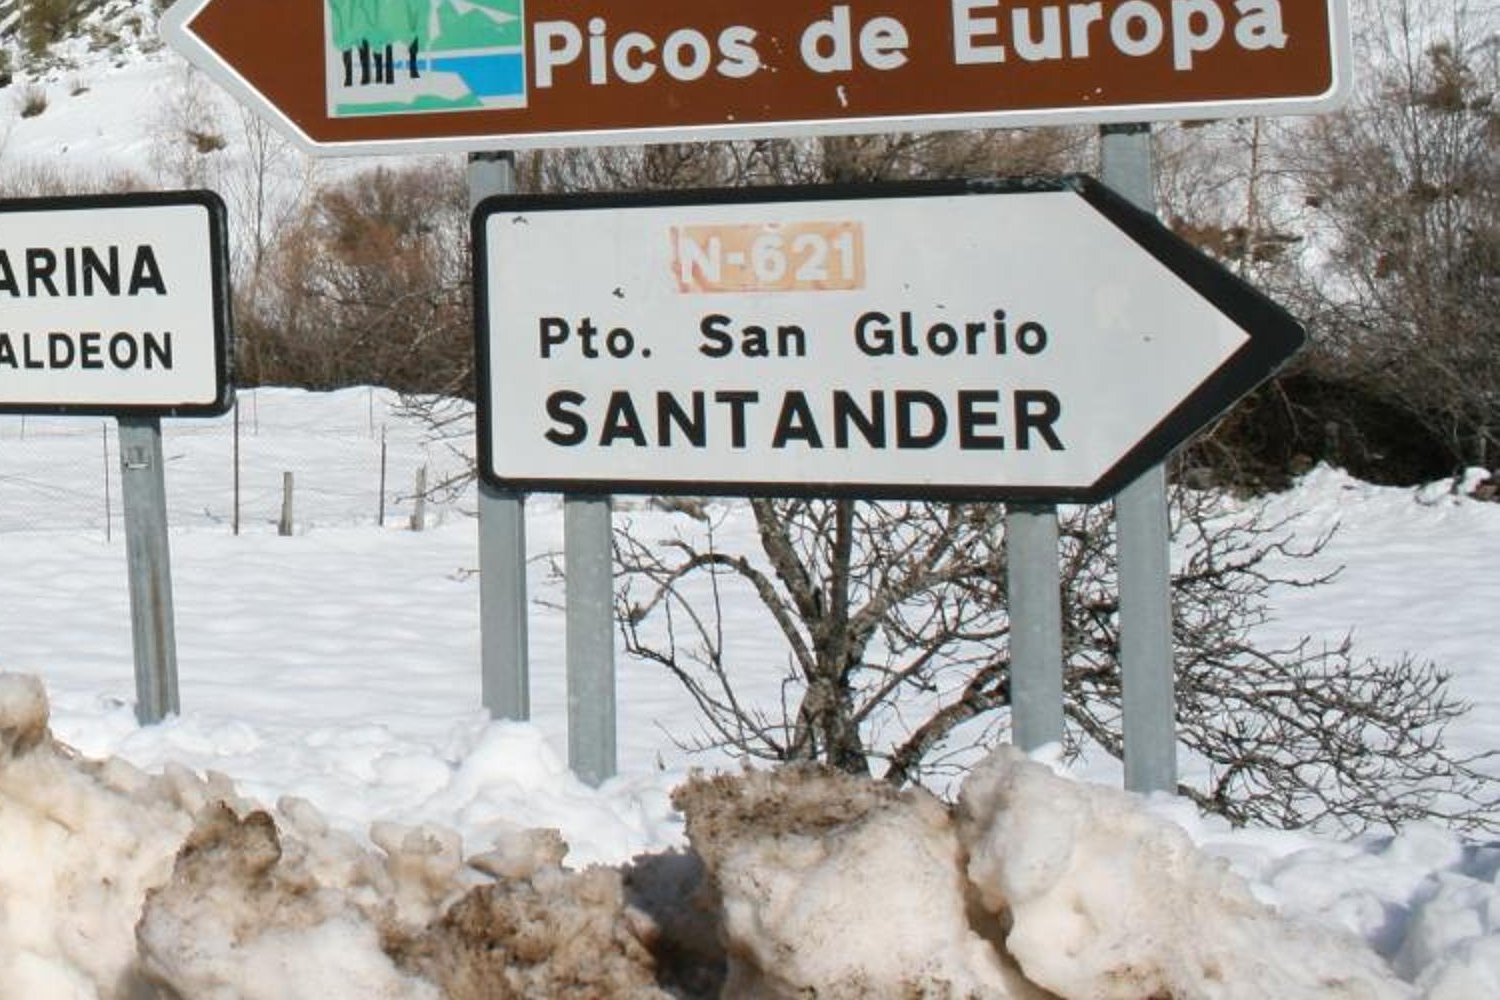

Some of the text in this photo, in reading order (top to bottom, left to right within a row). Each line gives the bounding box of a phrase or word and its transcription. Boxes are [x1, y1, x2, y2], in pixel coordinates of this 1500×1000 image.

[533, 17, 761, 88] Picos
[800, 5, 909, 73] de
[678, 231, 855, 282] N-621
[539, 309, 1048, 359] Pto. San Glorio
[544, 389, 1066, 451] SANTANDER
